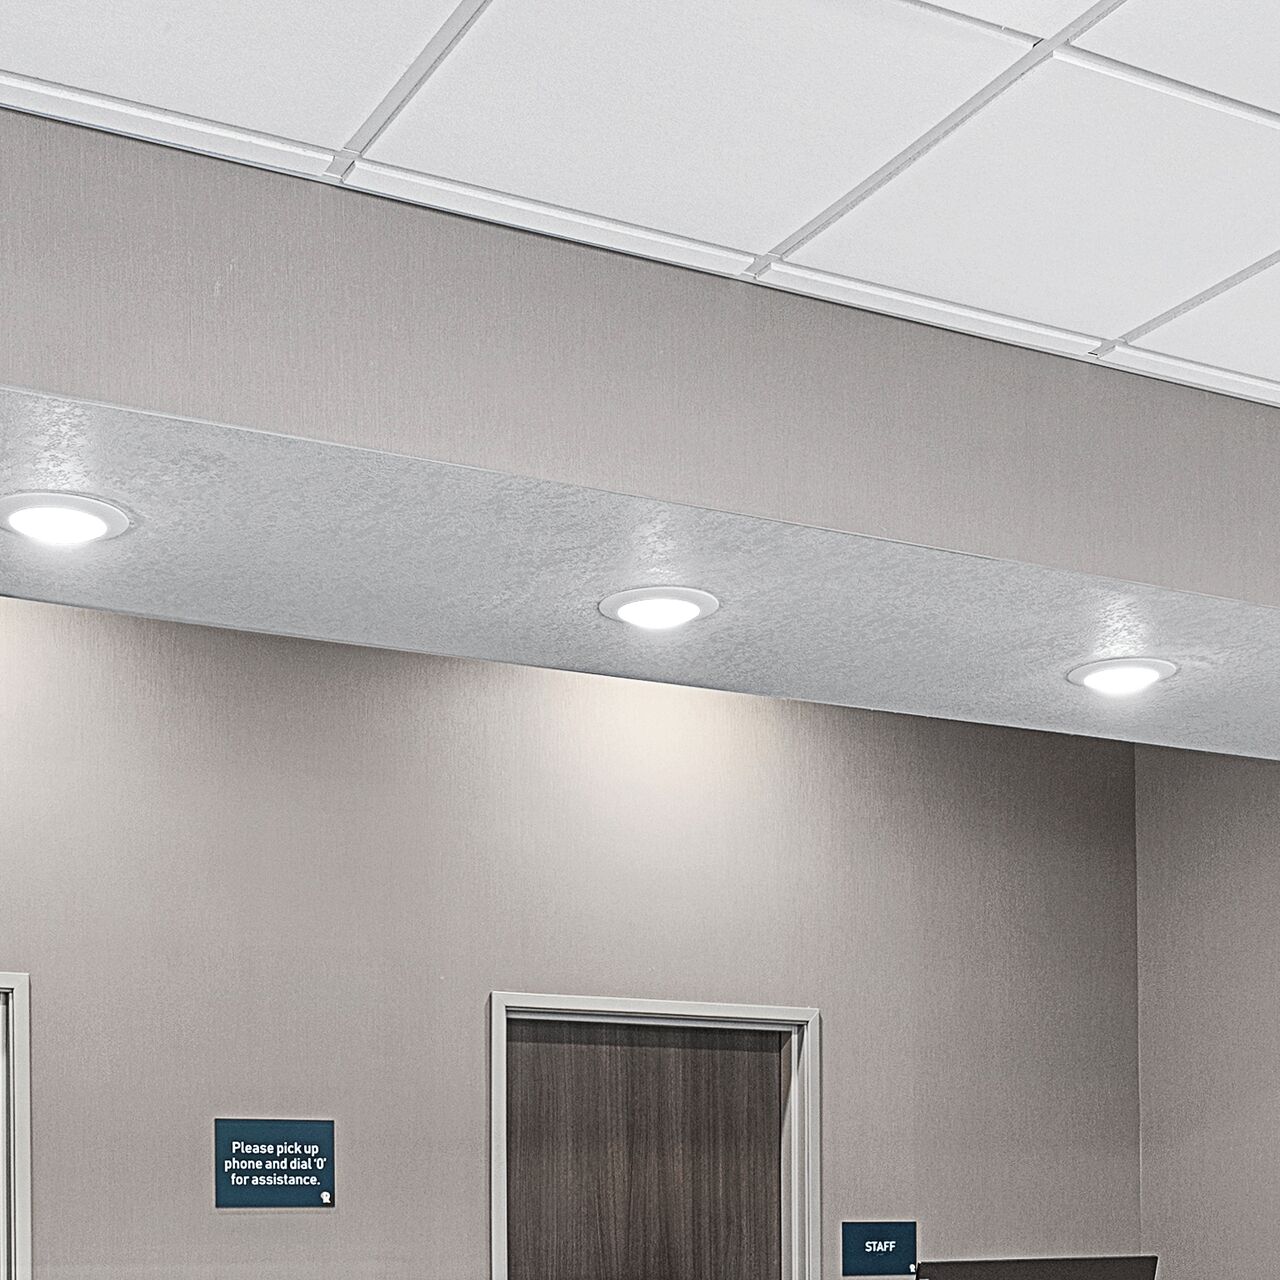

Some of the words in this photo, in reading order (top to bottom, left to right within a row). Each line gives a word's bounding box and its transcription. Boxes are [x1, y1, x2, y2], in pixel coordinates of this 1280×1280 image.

[232, 1142, 274, 1154] Please
[276, 1142, 302, 1156] pick
[304, 1144, 319, 1156] up
[224, 1158, 262, 1172] phone
[265, 1158, 288, 1170] and
[290, 1158, 312, 1170] dial
[230, 1173, 249, 1185] for
[252, 1173, 320, 1186] assistance.
[865, 1241, 896, 1252] STAFF
